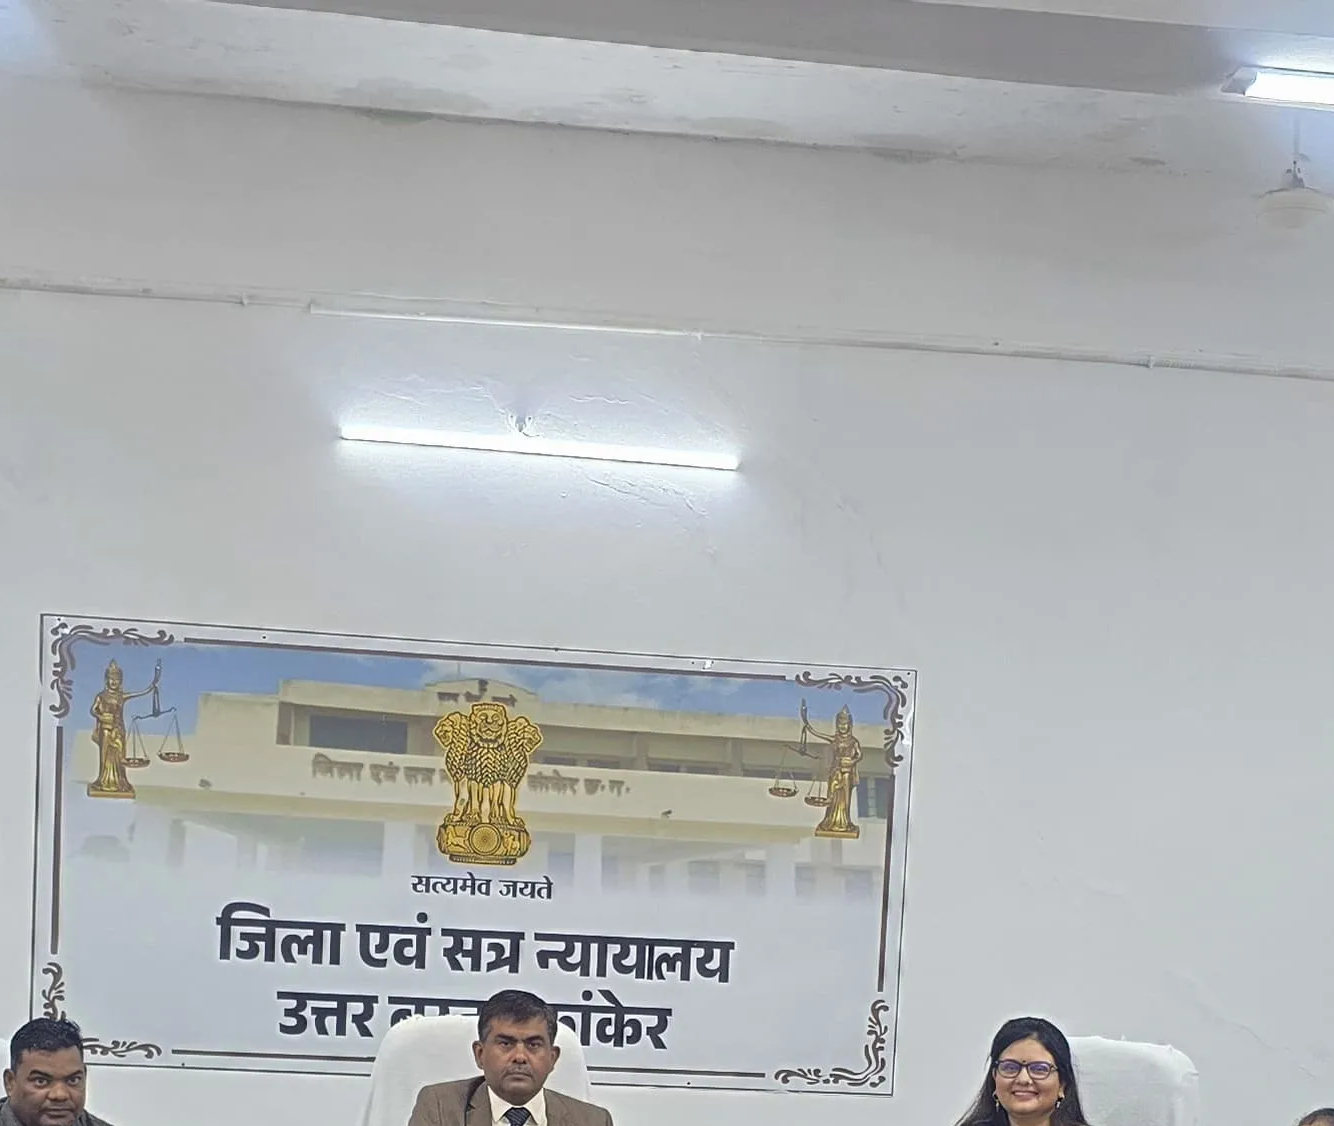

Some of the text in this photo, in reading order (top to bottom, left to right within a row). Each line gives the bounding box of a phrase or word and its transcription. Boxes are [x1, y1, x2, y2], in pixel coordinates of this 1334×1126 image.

[410, 872, 554, 900] सत्यमेव जयते
[216, 902, 736, 984] जिला एवं सत्र न्यायालय
[276, 991, 379, 1038] उत्तर
[546, 988, 672, 1050] ांकेर
